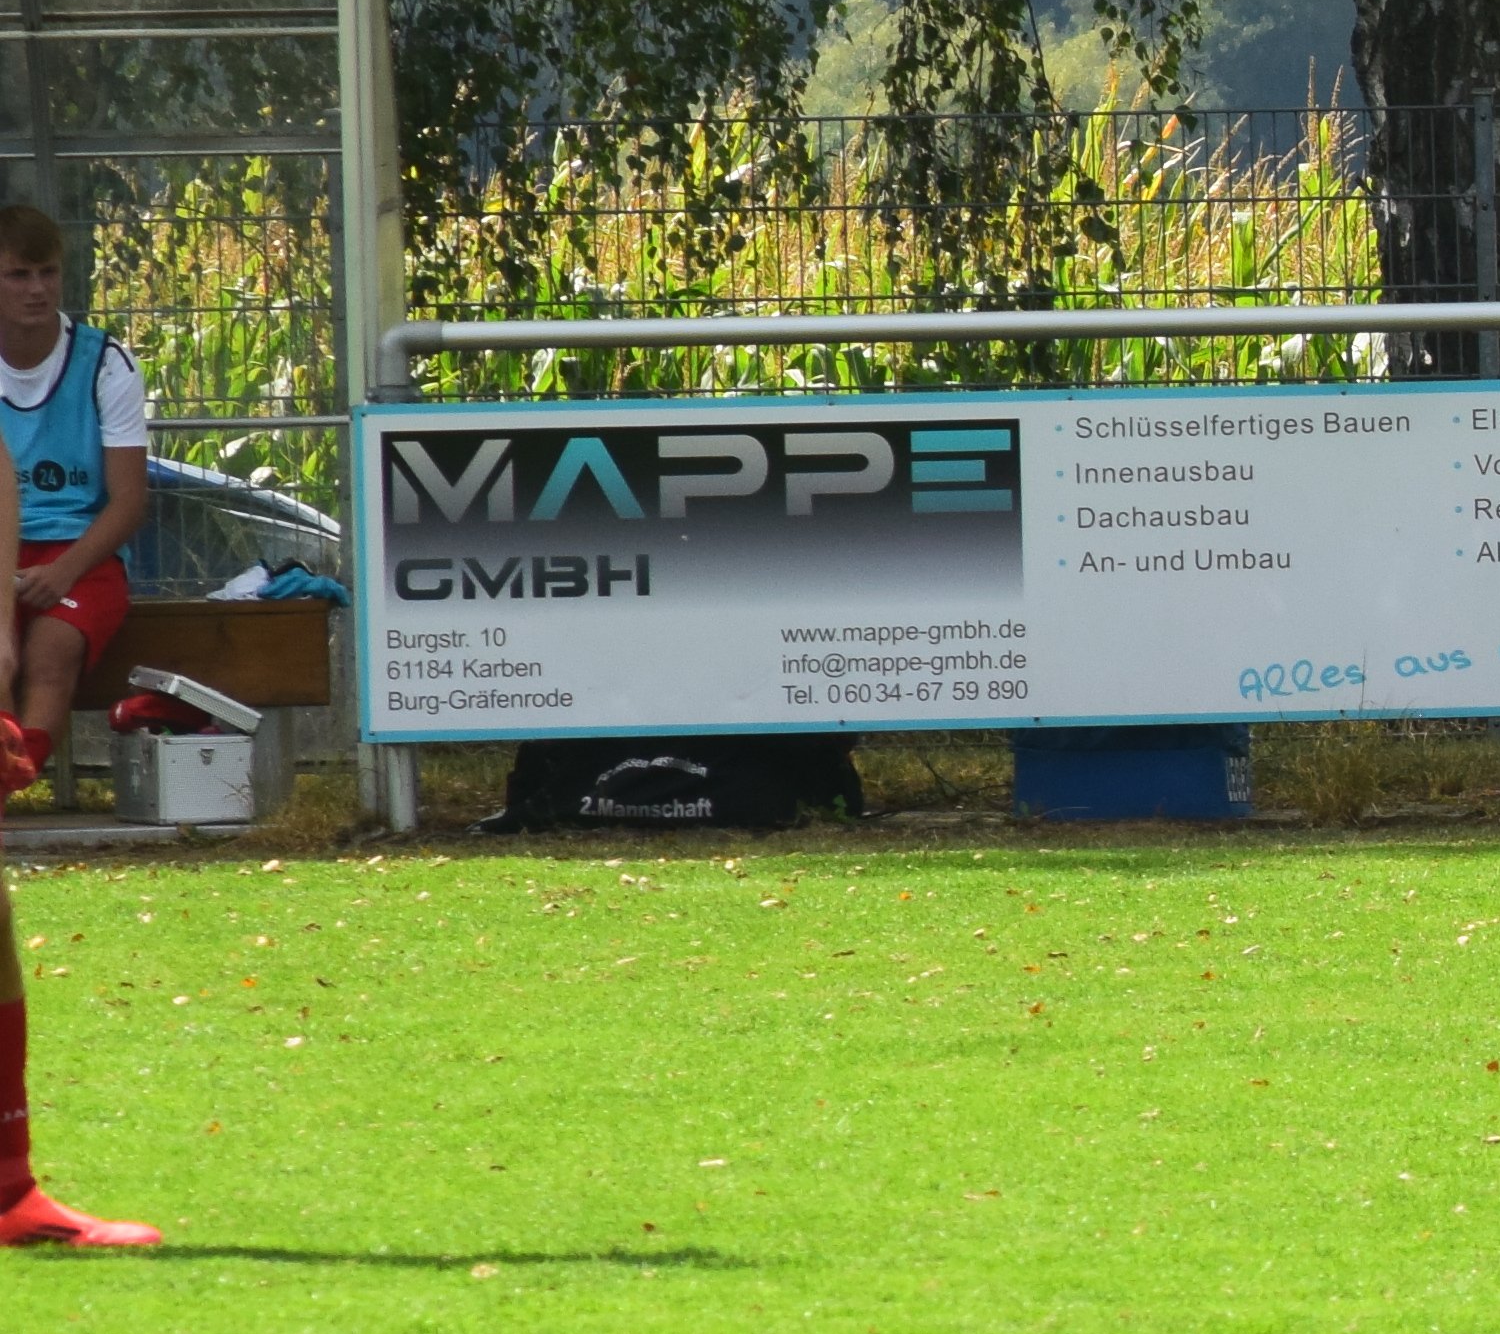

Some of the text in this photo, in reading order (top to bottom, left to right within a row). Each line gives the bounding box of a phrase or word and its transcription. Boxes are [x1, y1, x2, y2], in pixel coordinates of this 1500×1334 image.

[1075, 412, 1411, 441] Schlüsselfertiges Bauen
[391, 428, 1013, 525] MAPPE
[1075, 461, 1254, 484] Innenausbau
[1077, 505, 1250, 529] Dachausbau
[1079, 548, 1291, 573] An- und Umbau
[394, 553, 651, 601] GMBH
[386, 627, 507, 653] Burgstr. 10
[781, 619, 1027, 645] www.mappe-gmbh.de
[386, 658, 543, 680] 61184 Karben
[781, 650, 1027, 678] info@mappe-gmbh.de
[1238, 660, 1366, 702] Alles
[1394, 649, 1473, 677] aus
[387, 688, 574, 715] Burg-Gräfenrode
[781, 684, 819, 704] Tel.
[952, 680, 979, 700] 59
[987, 679, 1029, 700] 890
